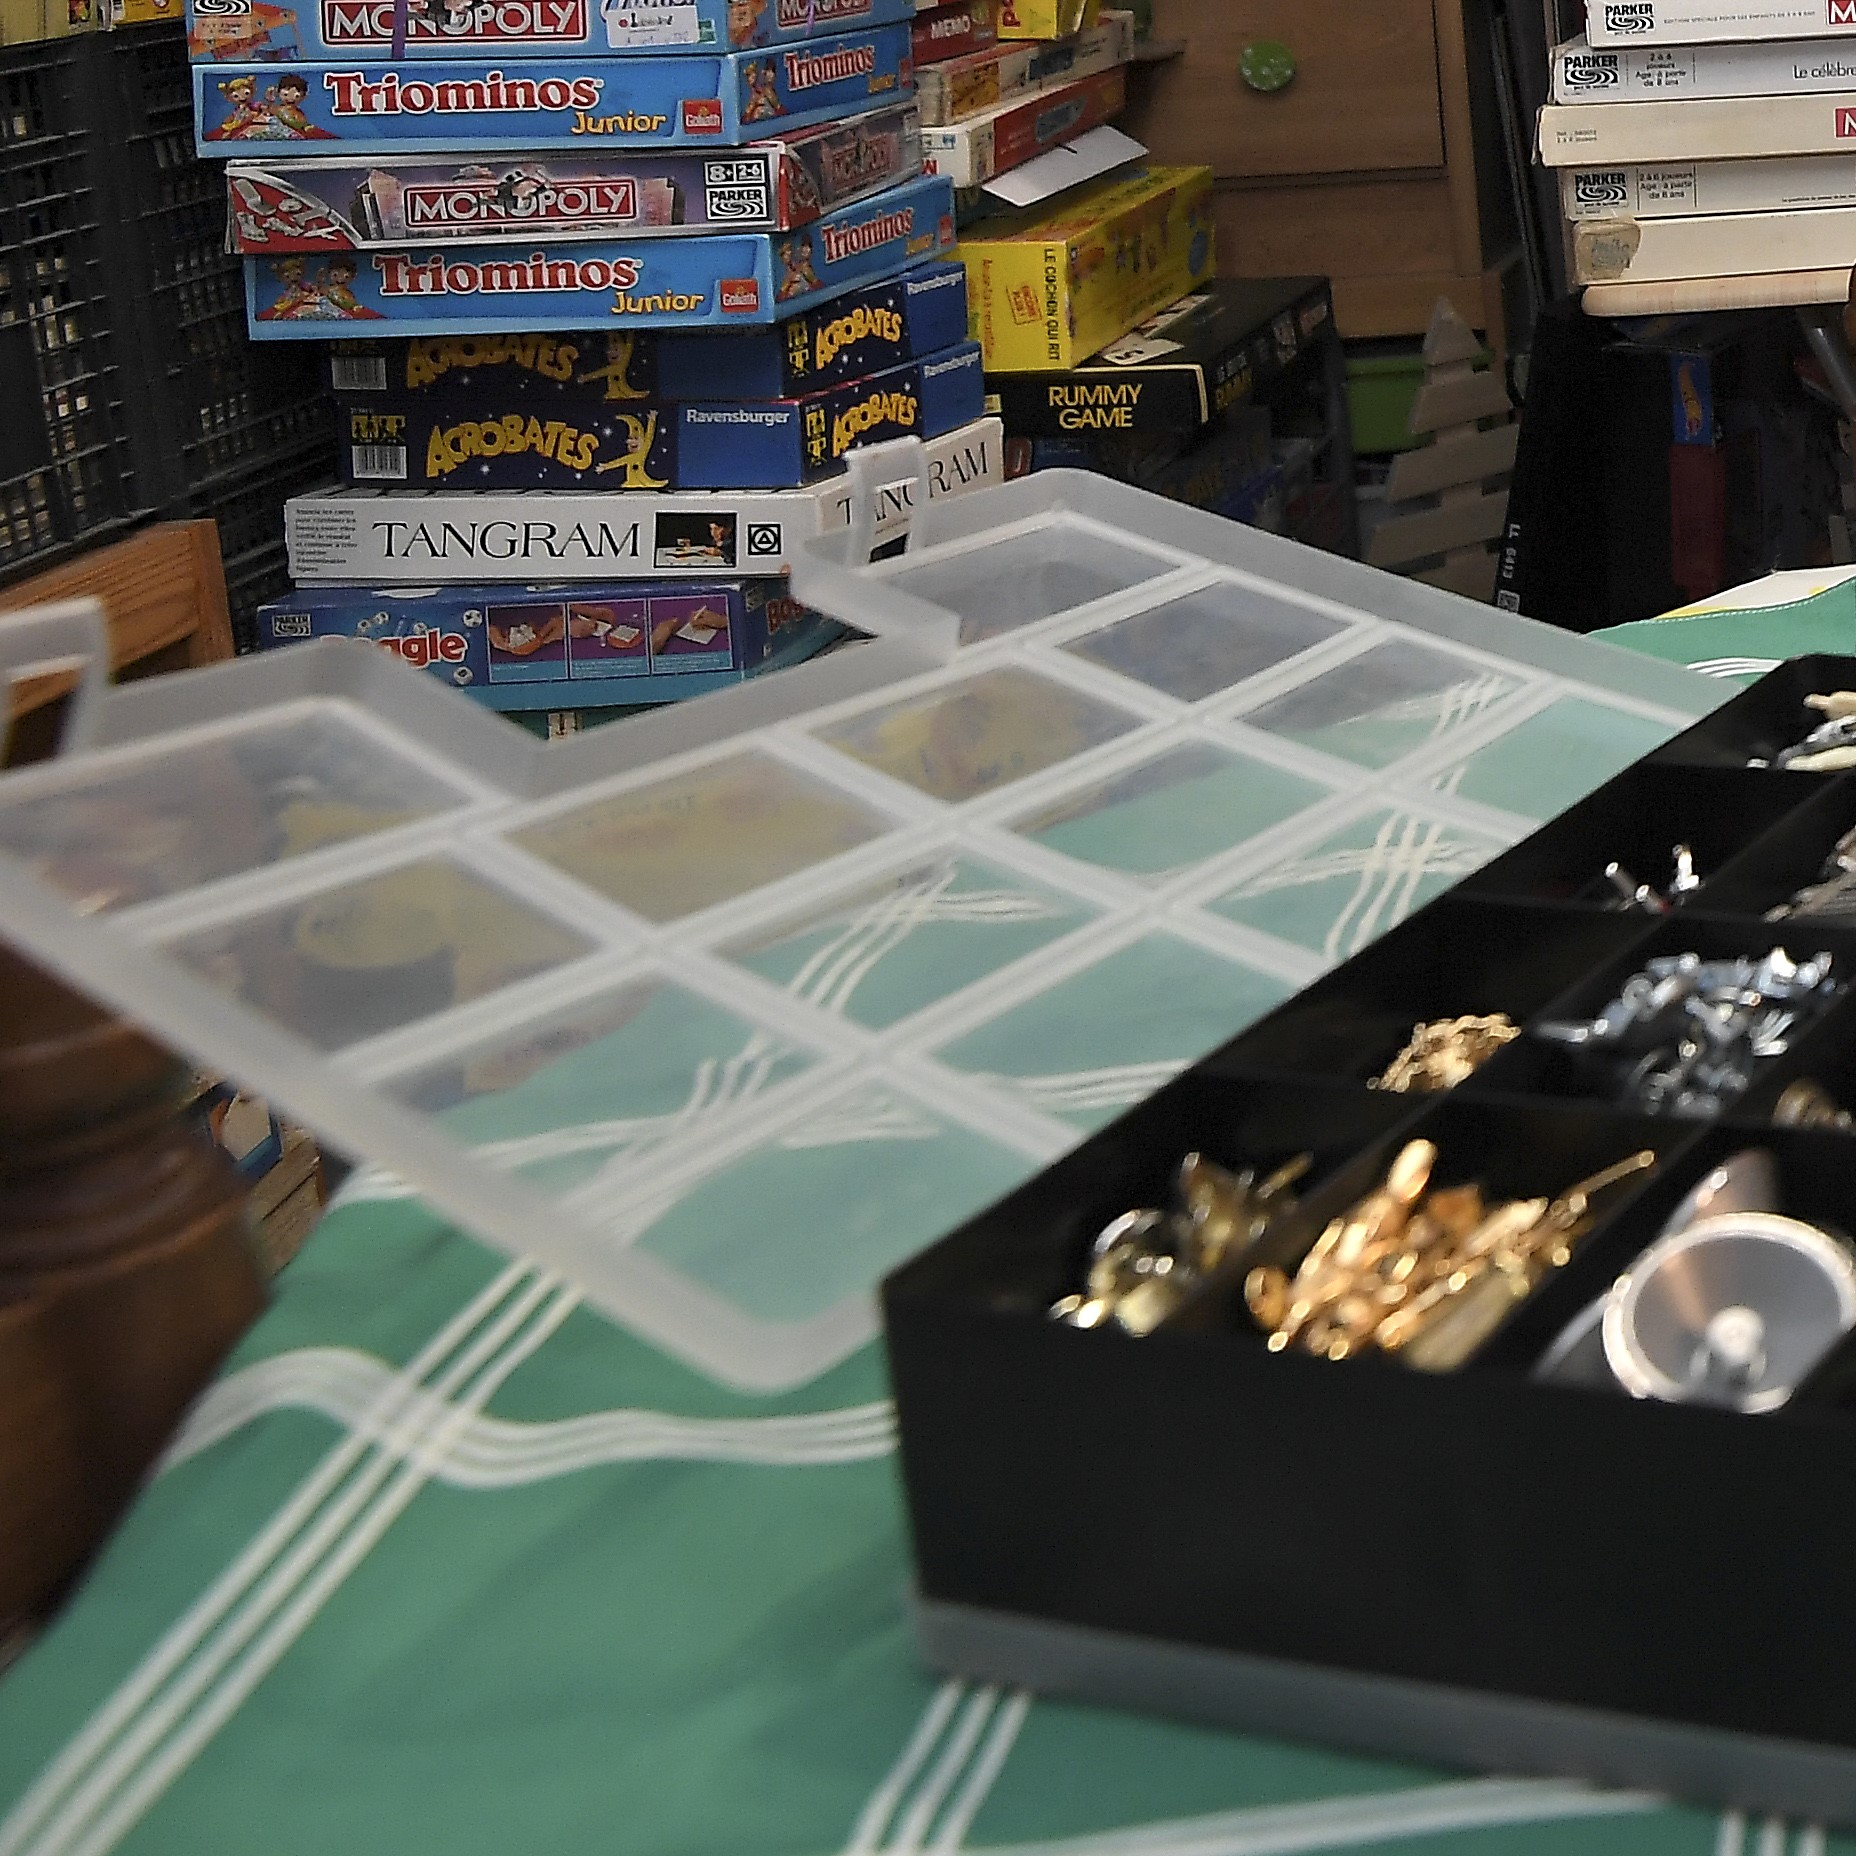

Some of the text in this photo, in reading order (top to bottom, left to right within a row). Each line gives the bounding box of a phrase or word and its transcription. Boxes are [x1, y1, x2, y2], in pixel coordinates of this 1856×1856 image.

[331, 0, 581, 38] MONOPOLY
[1604, 3, 1654, 16] PARKER
[930, 15, 972, 40] MEMO
[784, 44, 875, 92] Triominos
[1563, 54, 1618, 69] PARKER
[1793, 63, 1809, 79] Le
[324, 71, 600, 117] Triominos
[571, 109, 667, 136] Junior
[737, 161, 763, 180] 2-6
[1574, 172, 1627, 186] PARKER
[413, 183, 629, 223] MONOPOLY
[709, 187, 763, 204] PARKER
[821, 207, 914, 264] Triominos
[1043, 248, 1058, 264] LE
[371, 252, 642, 298] Triominos
[610, 291, 705, 316] Junior
[816, 306, 904, 371] ACROBATES
[1046, 319, 1060, 341] QUI
[1048, 383, 1143, 408] RUMMY
[686, 407, 790, 427] Ravensburger
[831, 390, 920, 458] ACROBATES
[1059, 407, 1134, 430] GAME
[424, 414, 600, 478] ACROBATES
[371, 520, 640, 559] TANGRAM
